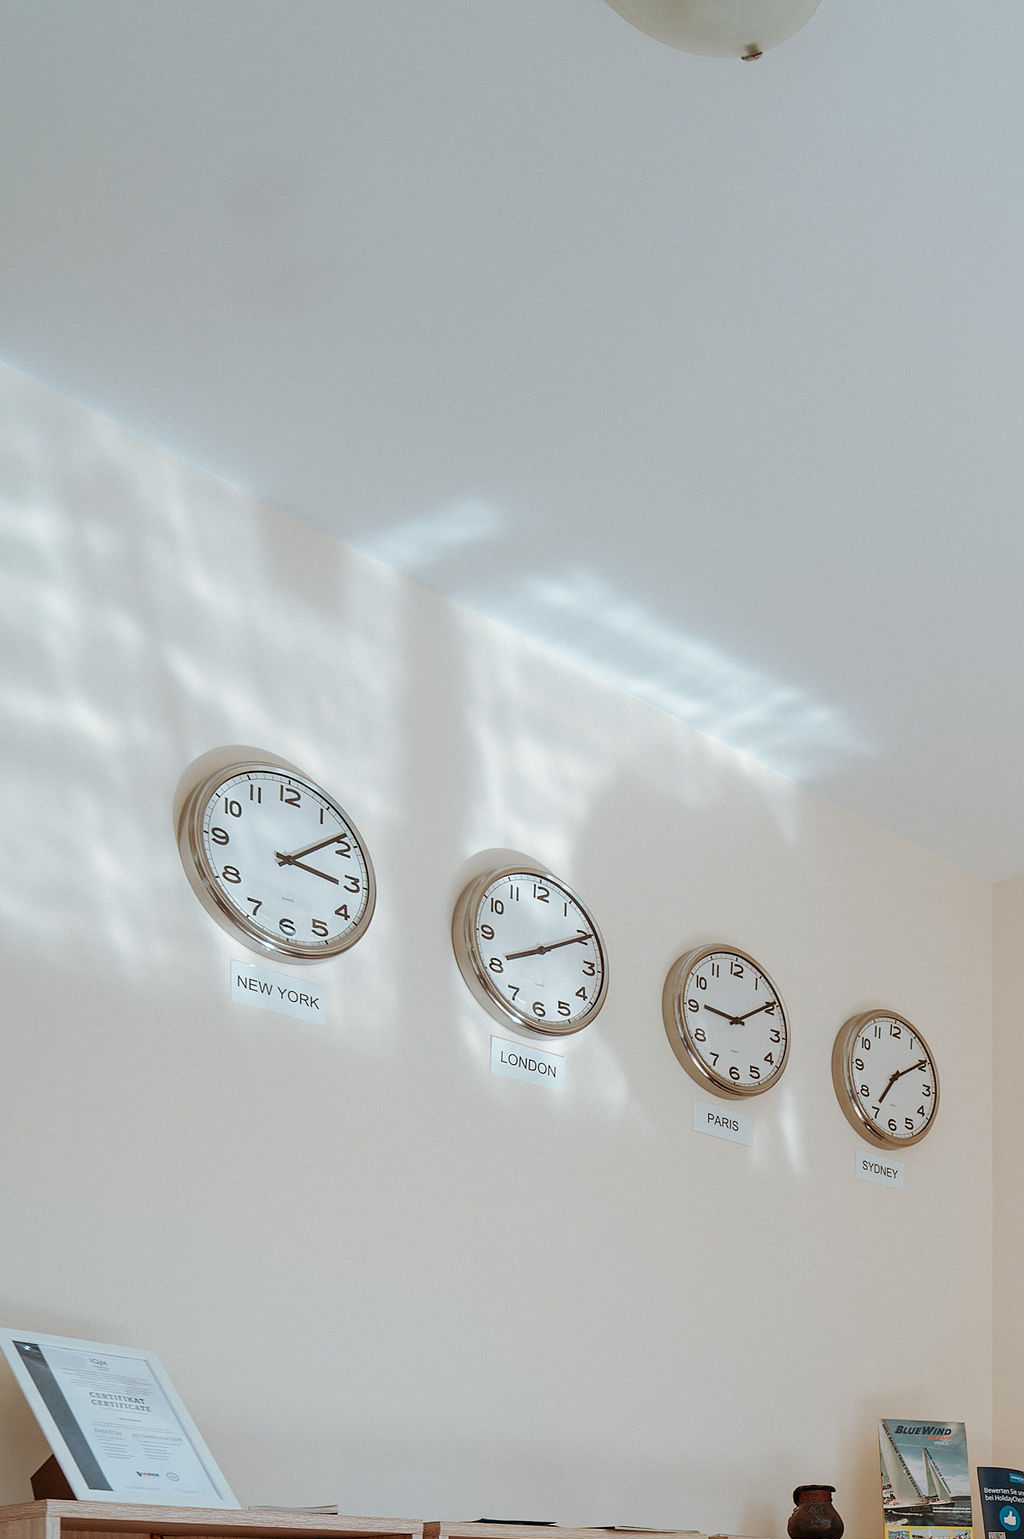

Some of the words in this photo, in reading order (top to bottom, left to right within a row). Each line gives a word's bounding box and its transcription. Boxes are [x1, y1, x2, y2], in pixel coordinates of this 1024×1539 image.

[249, 784, 262, 804] 11
[279, 785, 301, 808] 12
[224, 797, 242, 818] 10
[211, 827, 230, 845] 9
[334, 838, 352, 858] 2
[222, 865, 242, 884] 8
[343, 875, 360, 893] 3
[510, 885, 520, 901] 11
[533, 884, 550, 903] 12
[247, 897, 263, 916] 7
[334, 904, 351, 921] 4
[490, 898, 505, 915] 10
[279, 918, 296, 936] 6
[311, 919, 329, 937] 5
[480, 924, 495, 940] 9
[488, 957, 504, 974] 8
[582, 960, 596, 977] 3
[711, 963, 720, 978] 11
[730, 962, 744, 979] 12
[696, 975, 708, 990] 10
[237, 975, 273, 996] NEW
[277, 986, 320, 1010] YORK
[507, 984, 521, 1001] 7
[575, 987, 588, 1001] 4
[532, 1001, 546, 1017] 6
[557, 1001, 571, 1017] 5
[688, 999, 700, 1013] 9
[764, 1001, 775, 1016] 2
[694, 1028, 707, 1043] 8
[769, 1029, 781, 1044] 3
[874, 1026, 881, 1039] 11
[889, 1024, 901, 1039] 12
[861, 1037, 871, 1051] 10
[500, 1050, 557, 1078] LONDON
[709, 1052, 719, 1067] 7
[763, 1052, 775, 1065] 4
[855, 1058, 865, 1071] 9
[729, 1066, 741, 1080] 6
[749, 1066, 761, 1080] 5
[860, 1085, 870, 1097] 8
[922, 1084, 931, 1097] 3
[872, 1106, 880, 1119] 7
[917, 1105, 926, 1117] 4
[707, 1113, 739, 1132] PARIS
[888, 1119, 897, 1131] 6
[904, 1118, 914, 1130] 5
[862, 1160, 898, 1179] SYDNEY
[89, 1391, 145, 1404] CERTIFIKAT
[91, 1399, 152, 1412] CERTIFICATE
[983, 1487, 1010, 1495] Bewerten
